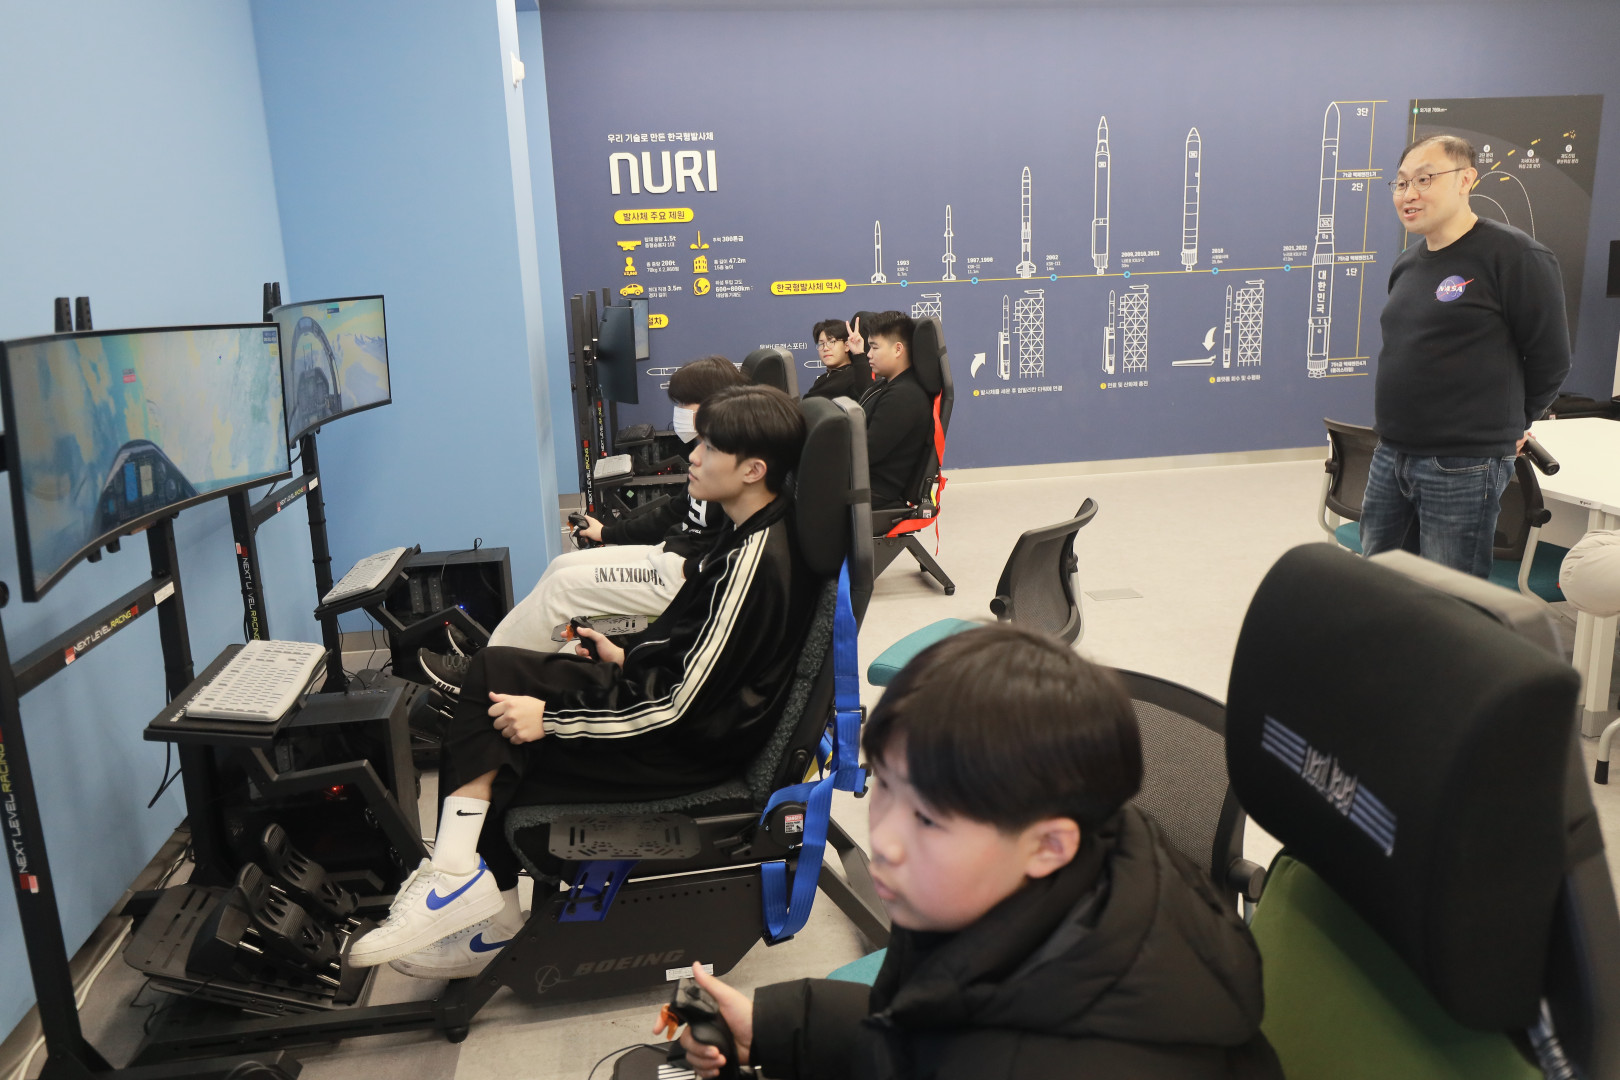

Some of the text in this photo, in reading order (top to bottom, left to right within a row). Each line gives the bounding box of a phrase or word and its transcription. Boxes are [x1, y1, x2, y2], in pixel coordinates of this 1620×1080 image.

[1356, 107, 1369, 117] 3단
[607, 131, 714, 144] 우리 기술로 만든 한국형발사체
[608, 149, 718, 195] NURI
[1351, 182, 1364, 191] 2단
[622, 210, 685, 222] 발사체 주요 제원
[1345, 267, 1358, 276] 1단
[776, 281, 841, 292] 한국형발사체 역사
[1438, 285, 1463, 293] NASA
[241, 557, 252, 581] NEXT
[73, 610, 132, 653] NEXT LEVEL RACING
[5, 793, 22, 838] LEVEL
[13, 839, 29, 874] NEXT
[573, 949, 685, 977] BOEING
